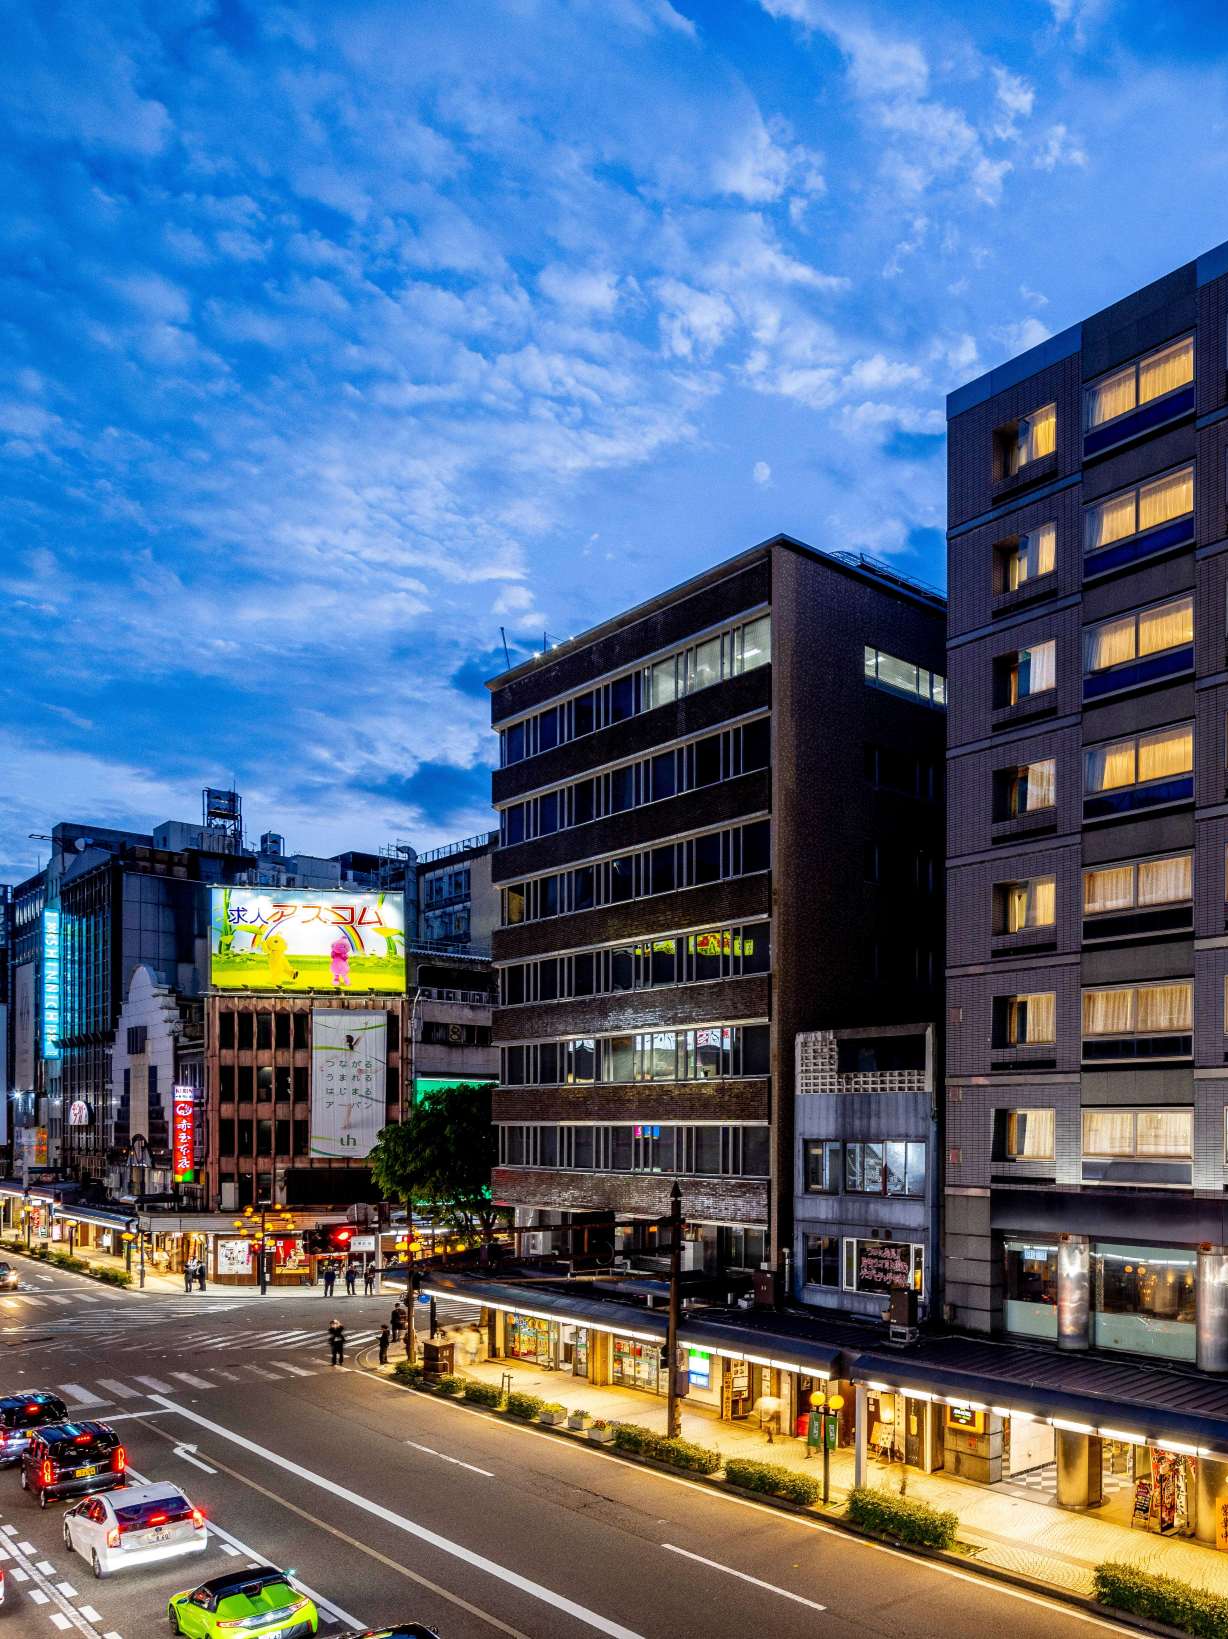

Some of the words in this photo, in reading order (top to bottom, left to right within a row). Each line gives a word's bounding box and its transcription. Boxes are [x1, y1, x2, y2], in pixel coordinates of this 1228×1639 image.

[326, 1060, 372, 1069] つながる
[326, 1073, 372, 1082] うまれる
[326, 1087, 372, 1096] はじまる
[325, 1101, 373, 1110] アーバン
